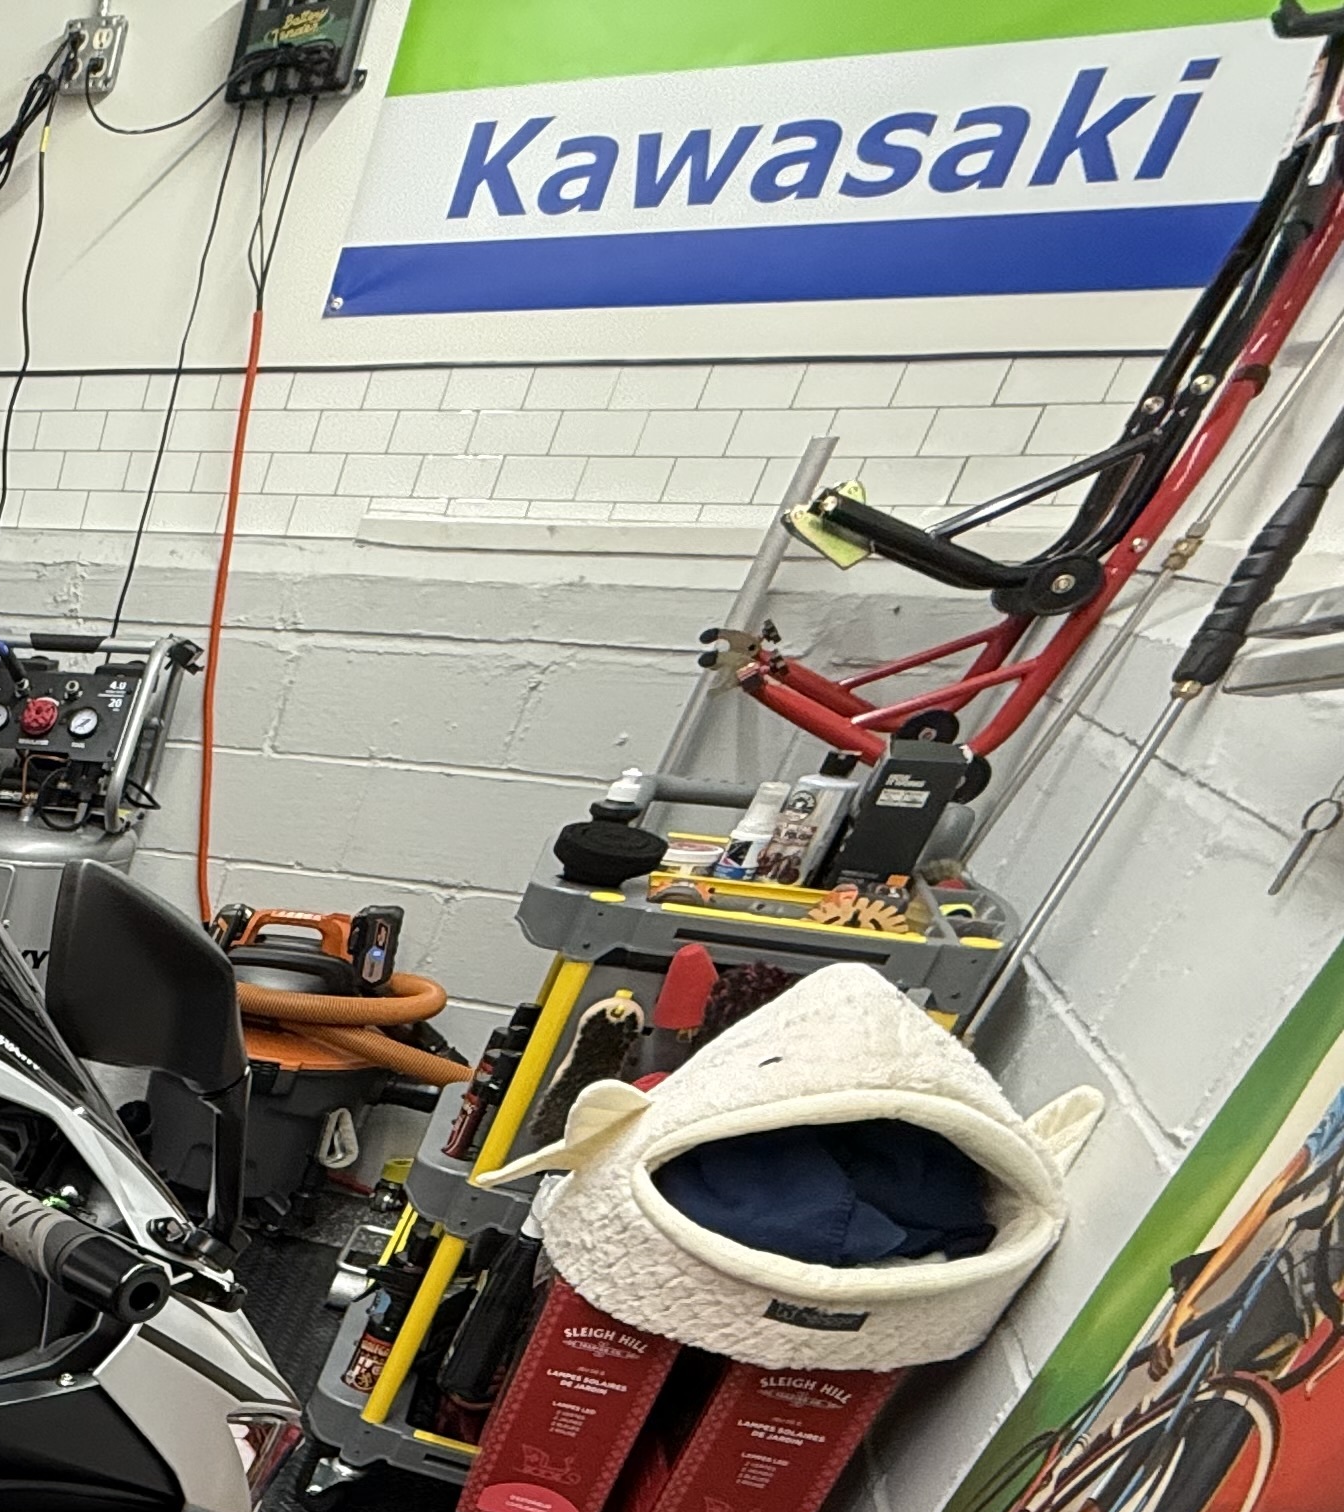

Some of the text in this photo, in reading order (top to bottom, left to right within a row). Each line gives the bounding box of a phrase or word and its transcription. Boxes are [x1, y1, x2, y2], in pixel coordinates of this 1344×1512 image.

[446, 56, 1222, 220] Kawasaki
[108, 698, 123, 708] 20
[563, 1326, 649, 1354] SLEIGH HILL
[760, 1375, 854, 1405] SLEIGH HILL
